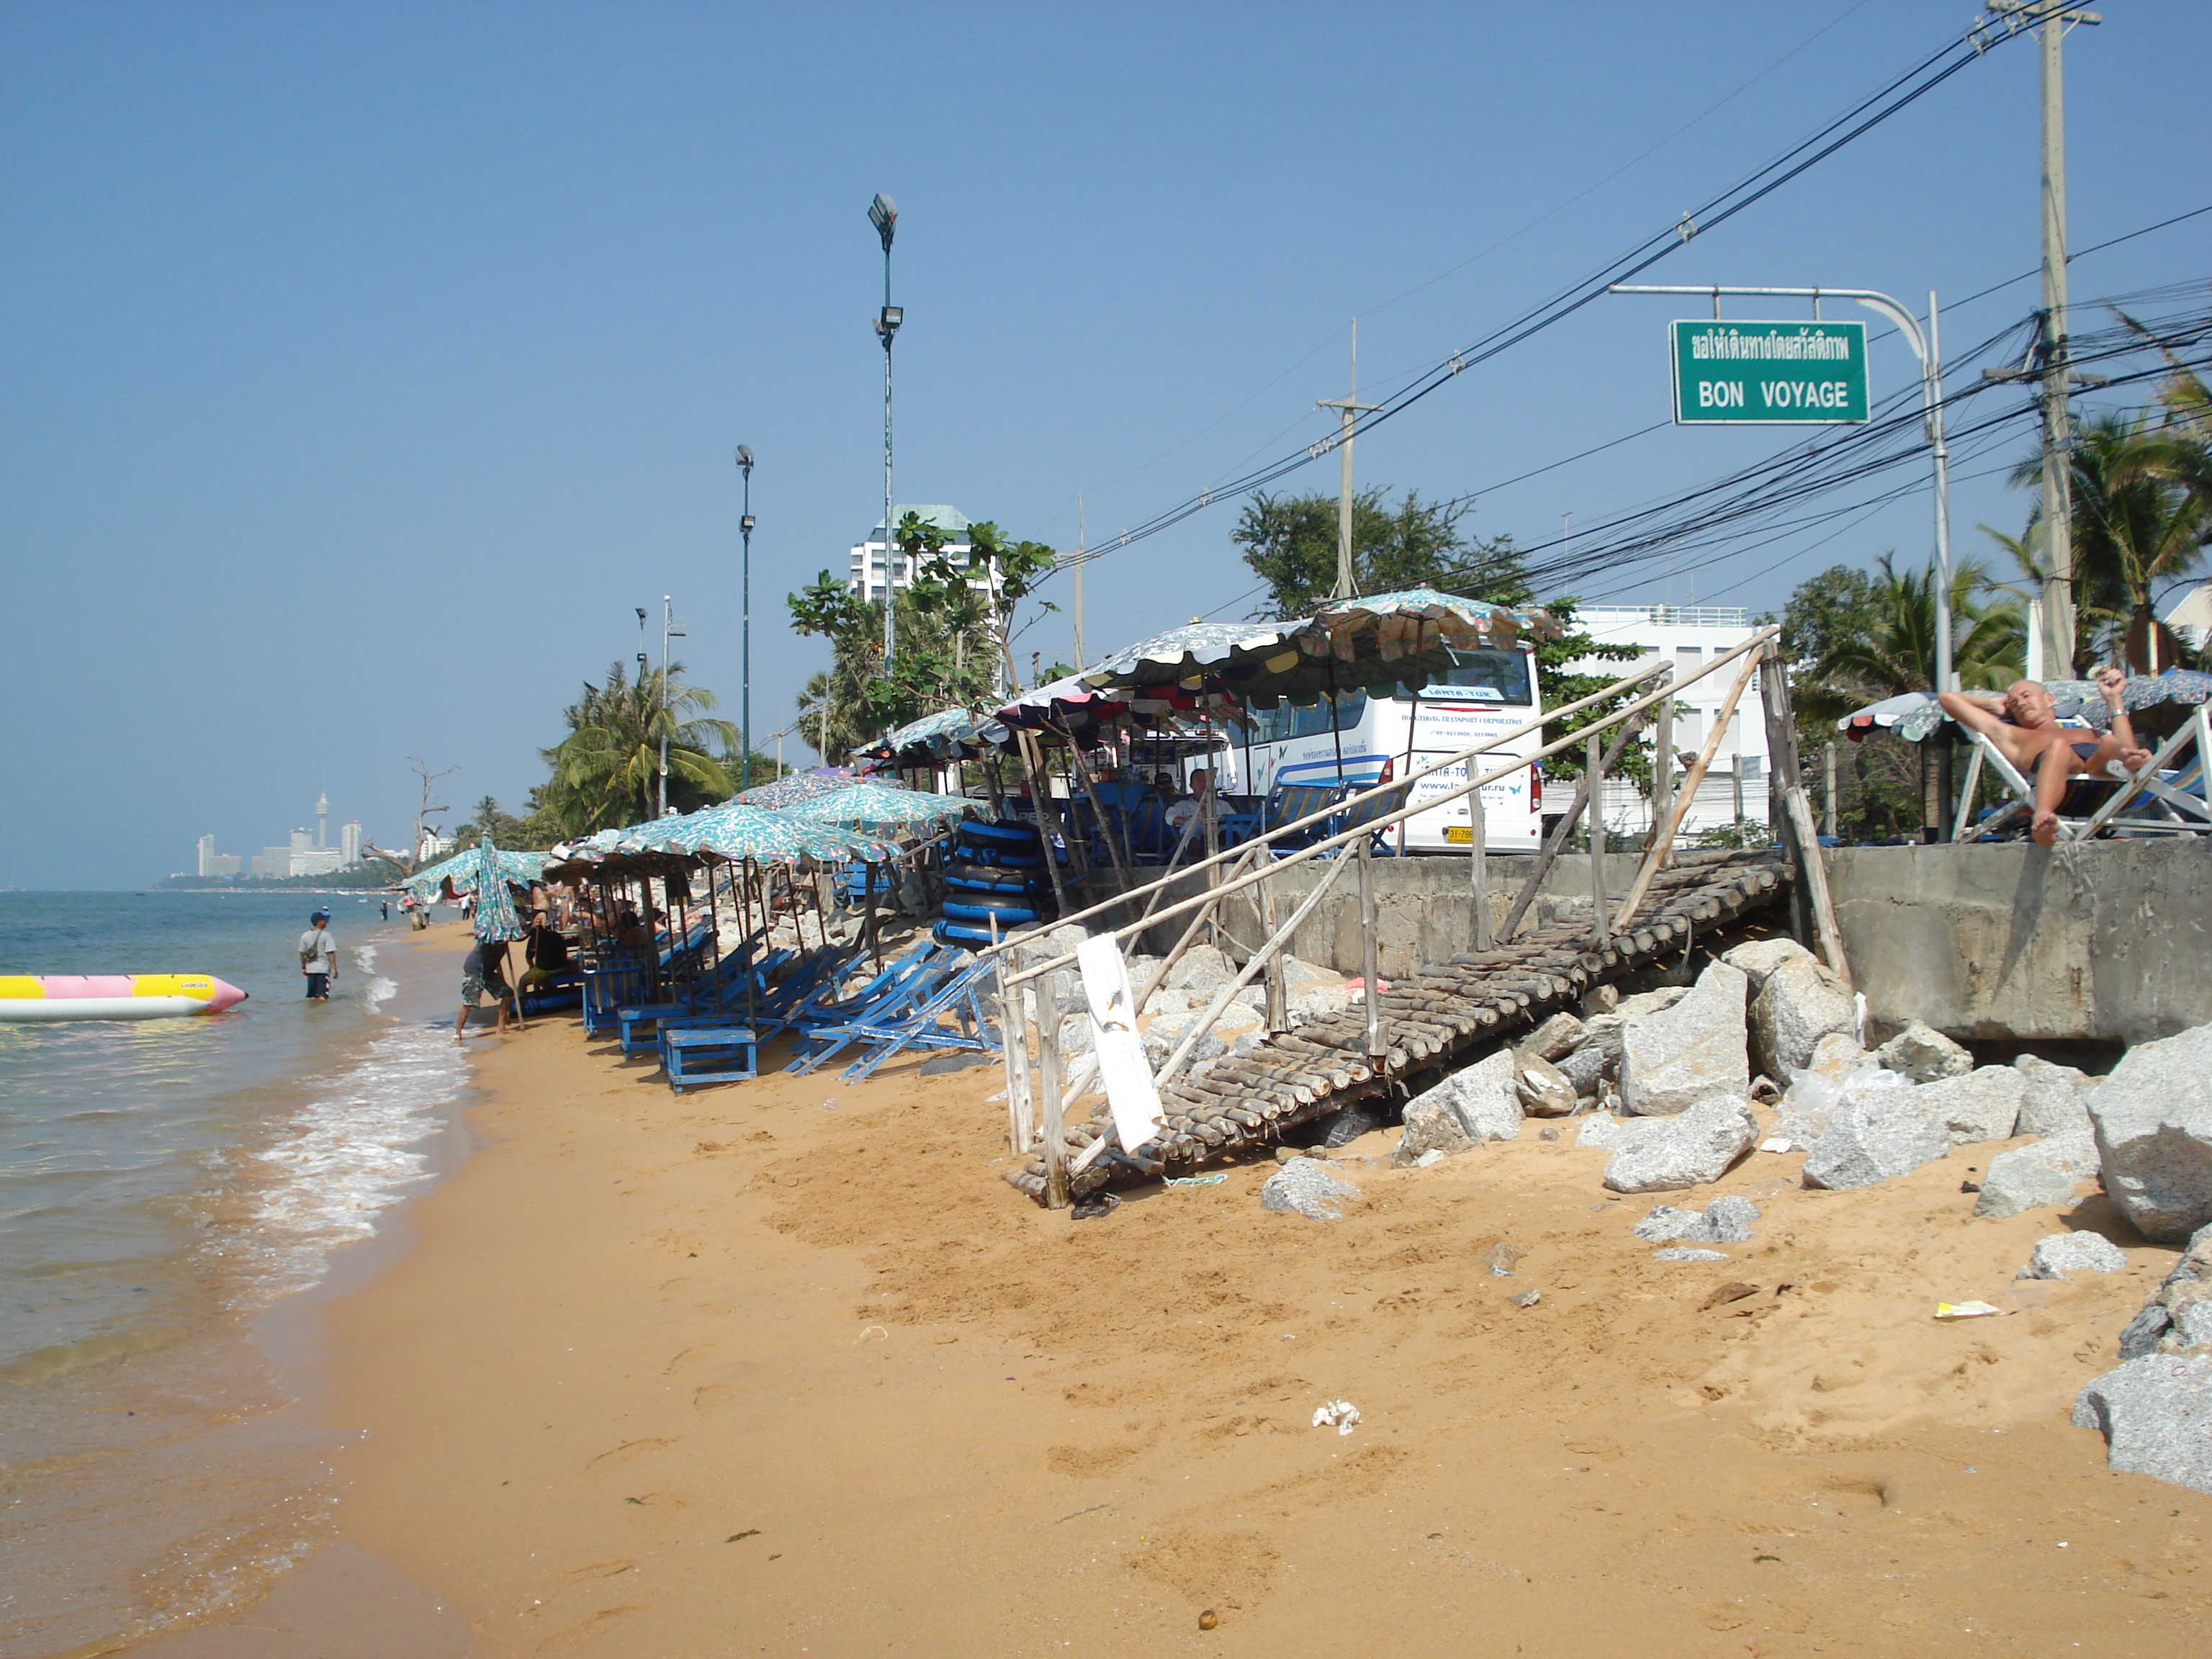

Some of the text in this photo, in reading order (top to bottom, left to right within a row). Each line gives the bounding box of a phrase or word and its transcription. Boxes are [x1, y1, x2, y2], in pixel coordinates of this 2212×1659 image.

[1691, 327, 1849, 359] ขอให้เดินทางโดยสวัสดิภาพ
[1699, 381, 1848, 408] BON VOYAGE
[1429, 689, 1492, 698] LANTA-TUR
[1401, 714, 1441, 722] HOGTHONG
